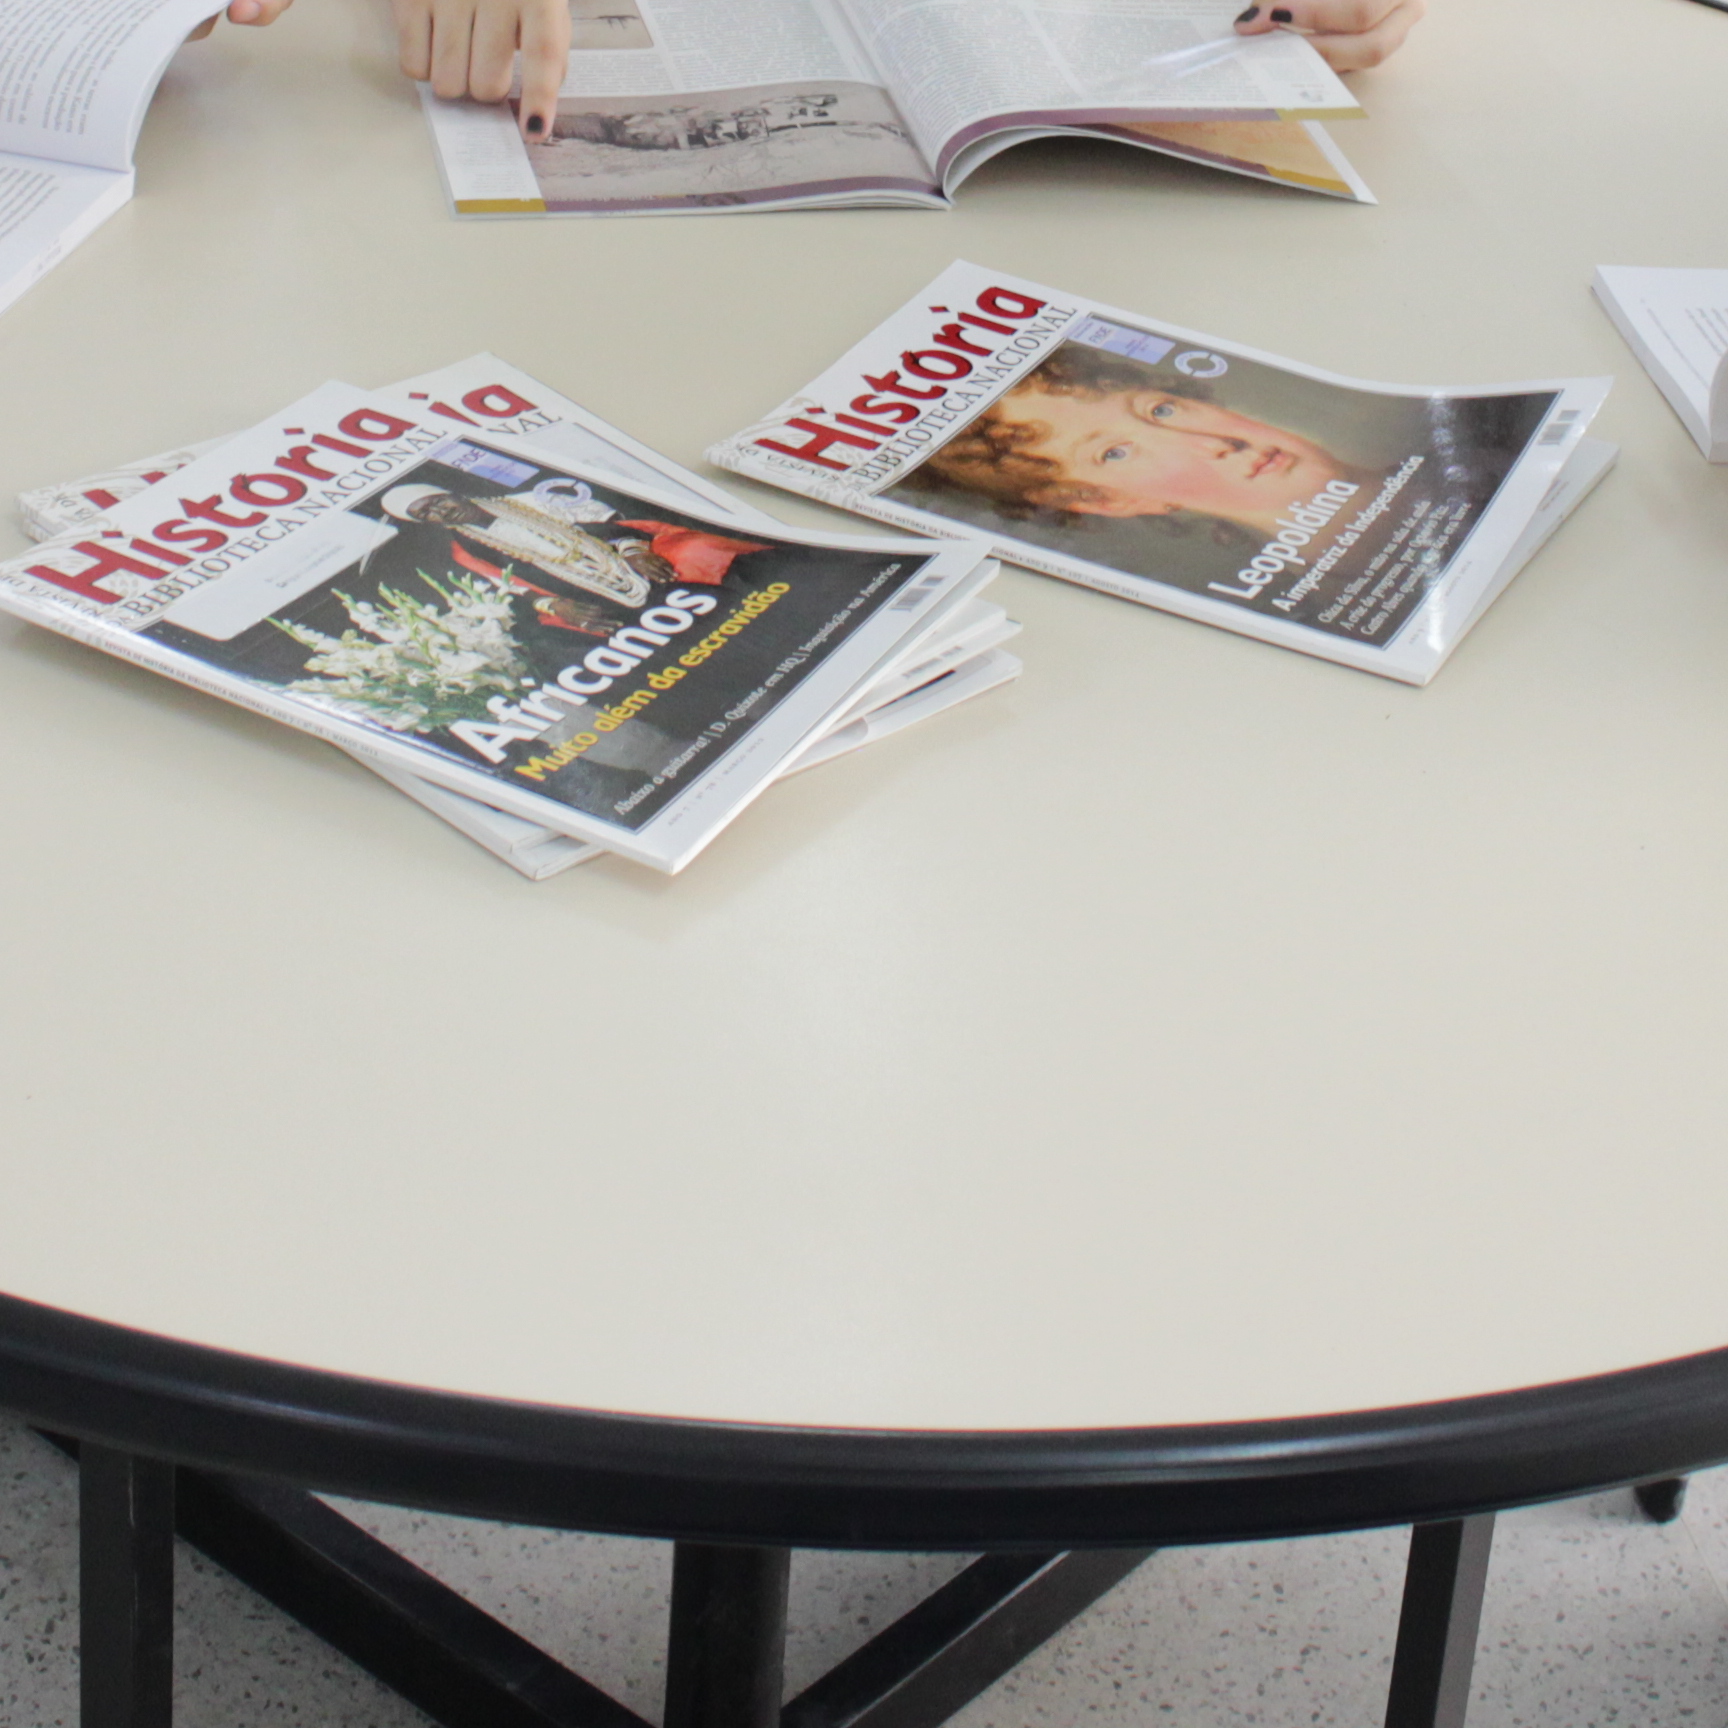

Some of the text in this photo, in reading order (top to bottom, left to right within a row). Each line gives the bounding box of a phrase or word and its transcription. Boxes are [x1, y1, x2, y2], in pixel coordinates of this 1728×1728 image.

[852, 389, 983, 482] BIBLIOTECA
[964, 305, 1078, 391] NACIONAL
[123, 518, 304, 617] BIBLIOTECA
[293, 427, 449, 517] NACIONAL
[1207, 479, 1360, 599] Leopoldina
[1272, 455, 1425, 612] A imperatriz da Independência
[104, 641, 132, 657] REVISTA
[133, 650, 142, 661] DE
[175, 668, 186, 679] DA
[187, 674, 228, 696] BIBLIOTECA
[228, 690, 264, 713] NACIONAL
[449, 588, 717, 764] Africanos
[515, 581, 791, 781] Muito além da escravidão
[614, 783, 655, 816] Abaixo
[653, 776, 664, 786] a
[661, 735, 711, 779] guitarra!
[724, 686, 767, 721] Quixote
[765, 672, 785, 688] em
[777, 655, 806, 674] HQ
[847, 596, 865, 610] na
